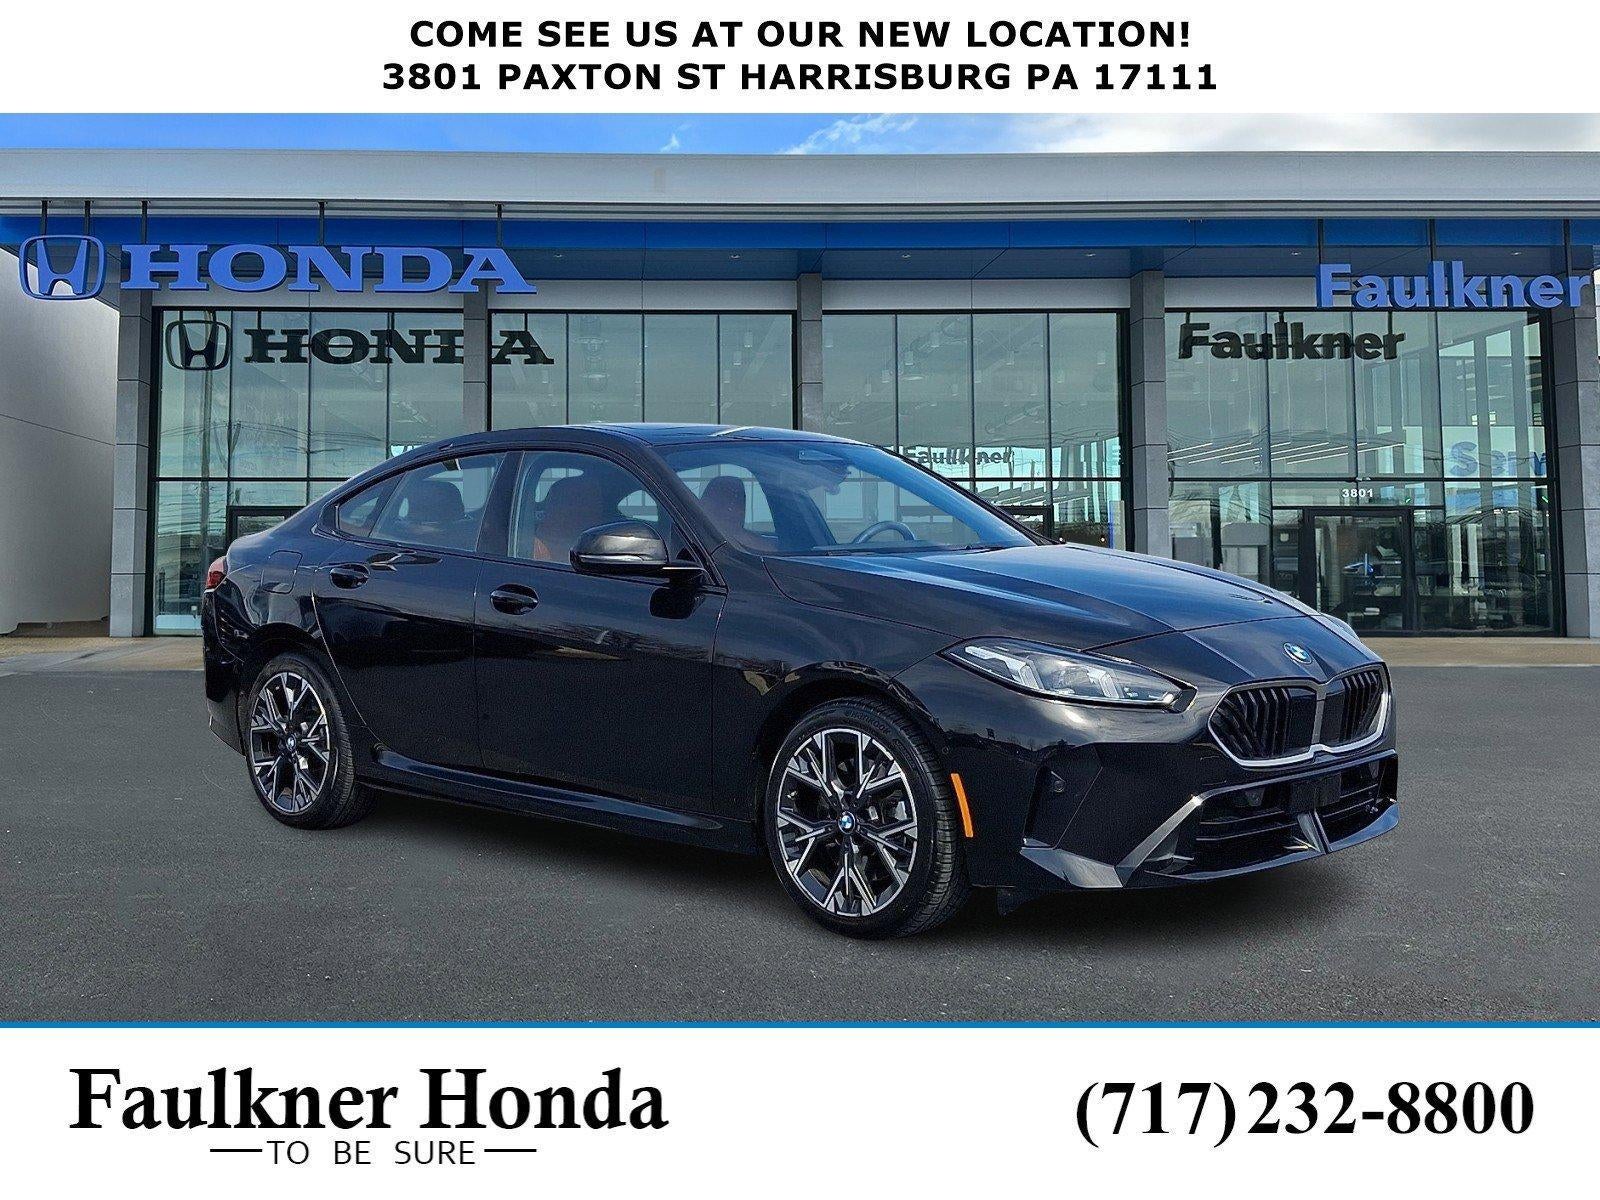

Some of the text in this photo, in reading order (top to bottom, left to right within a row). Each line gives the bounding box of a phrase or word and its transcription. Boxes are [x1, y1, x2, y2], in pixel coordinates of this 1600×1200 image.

[121, 244, 537, 295] HONDA
[1316, 260, 1591, 309] Faulkner
[1178, 321, 1407, 361] Faulkner
[1341, 488, 1374, 498] 3801
